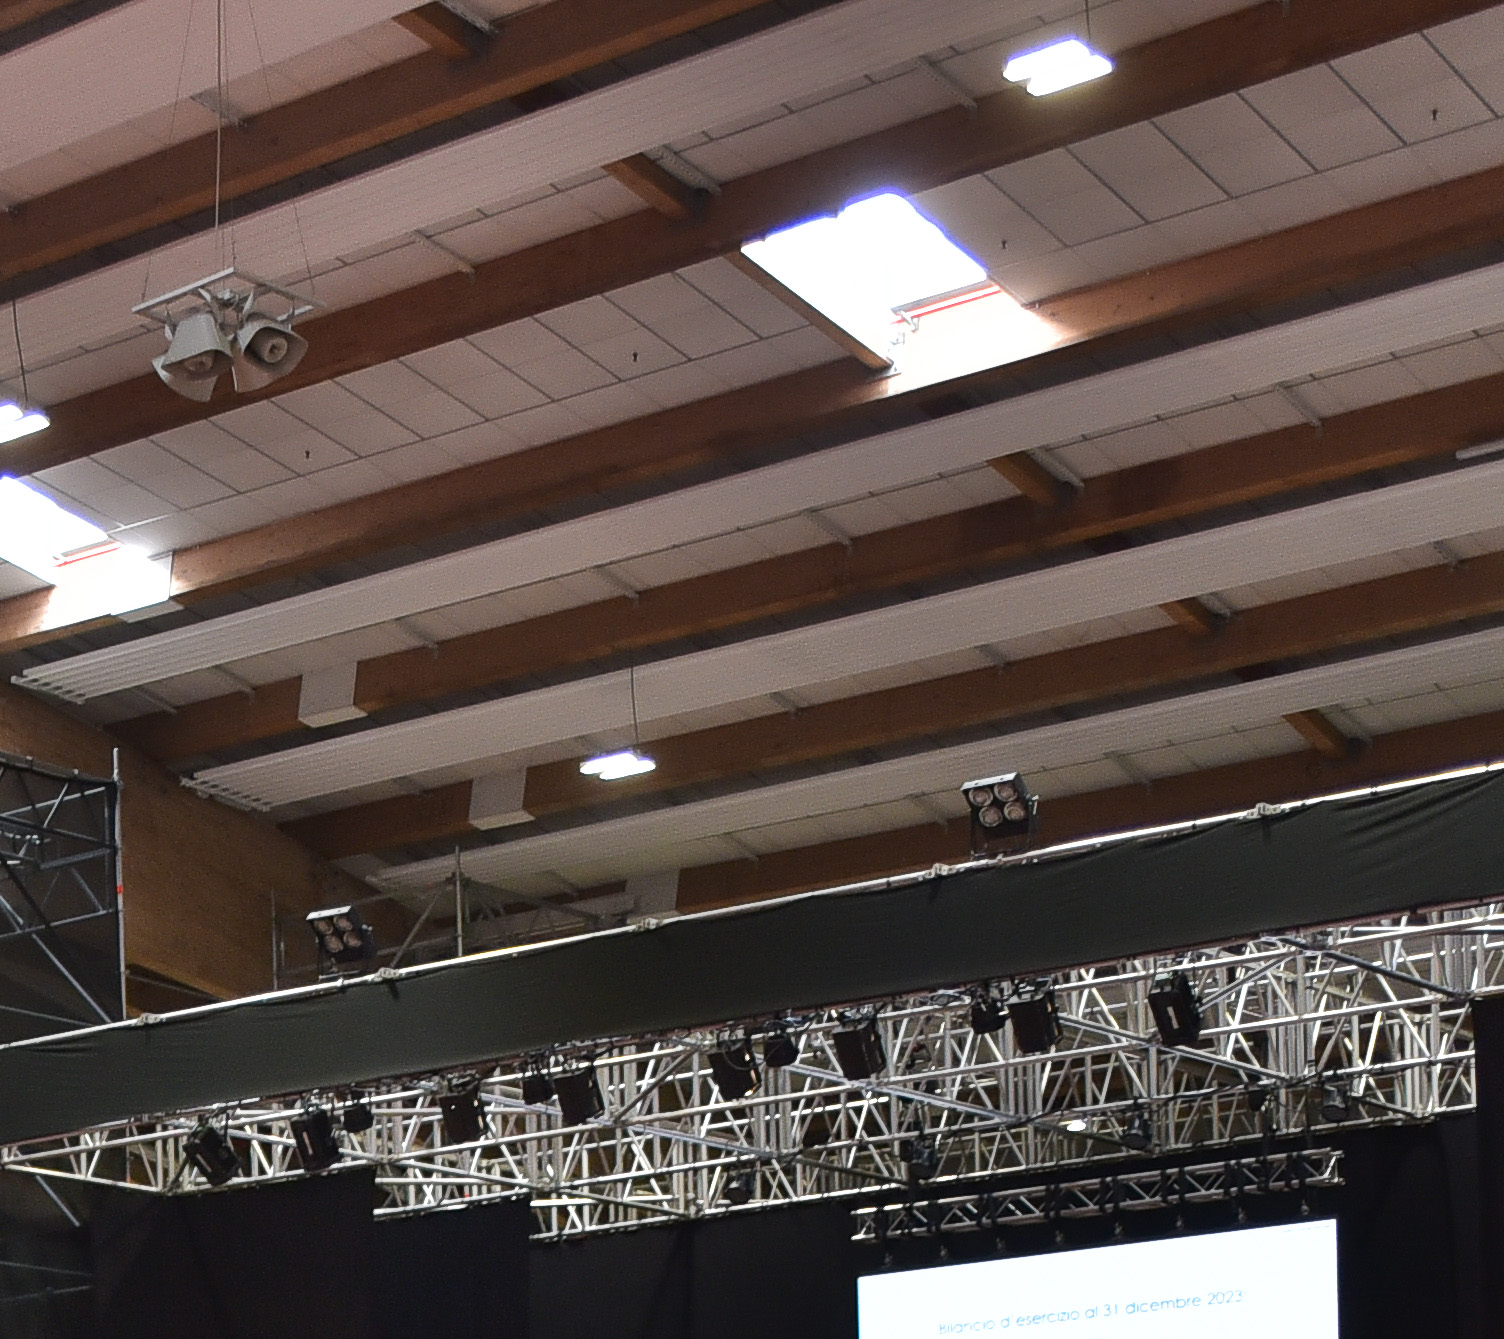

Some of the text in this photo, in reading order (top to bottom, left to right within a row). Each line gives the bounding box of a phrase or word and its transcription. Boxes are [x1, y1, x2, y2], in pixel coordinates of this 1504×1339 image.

[1085, 1306, 1098, 1319] al
[1104, 1304, 1118, 1317] 31
[1126, 1294, 1202, 1315] dicembre
[1208, 1289, 1243, 1305] 2023
